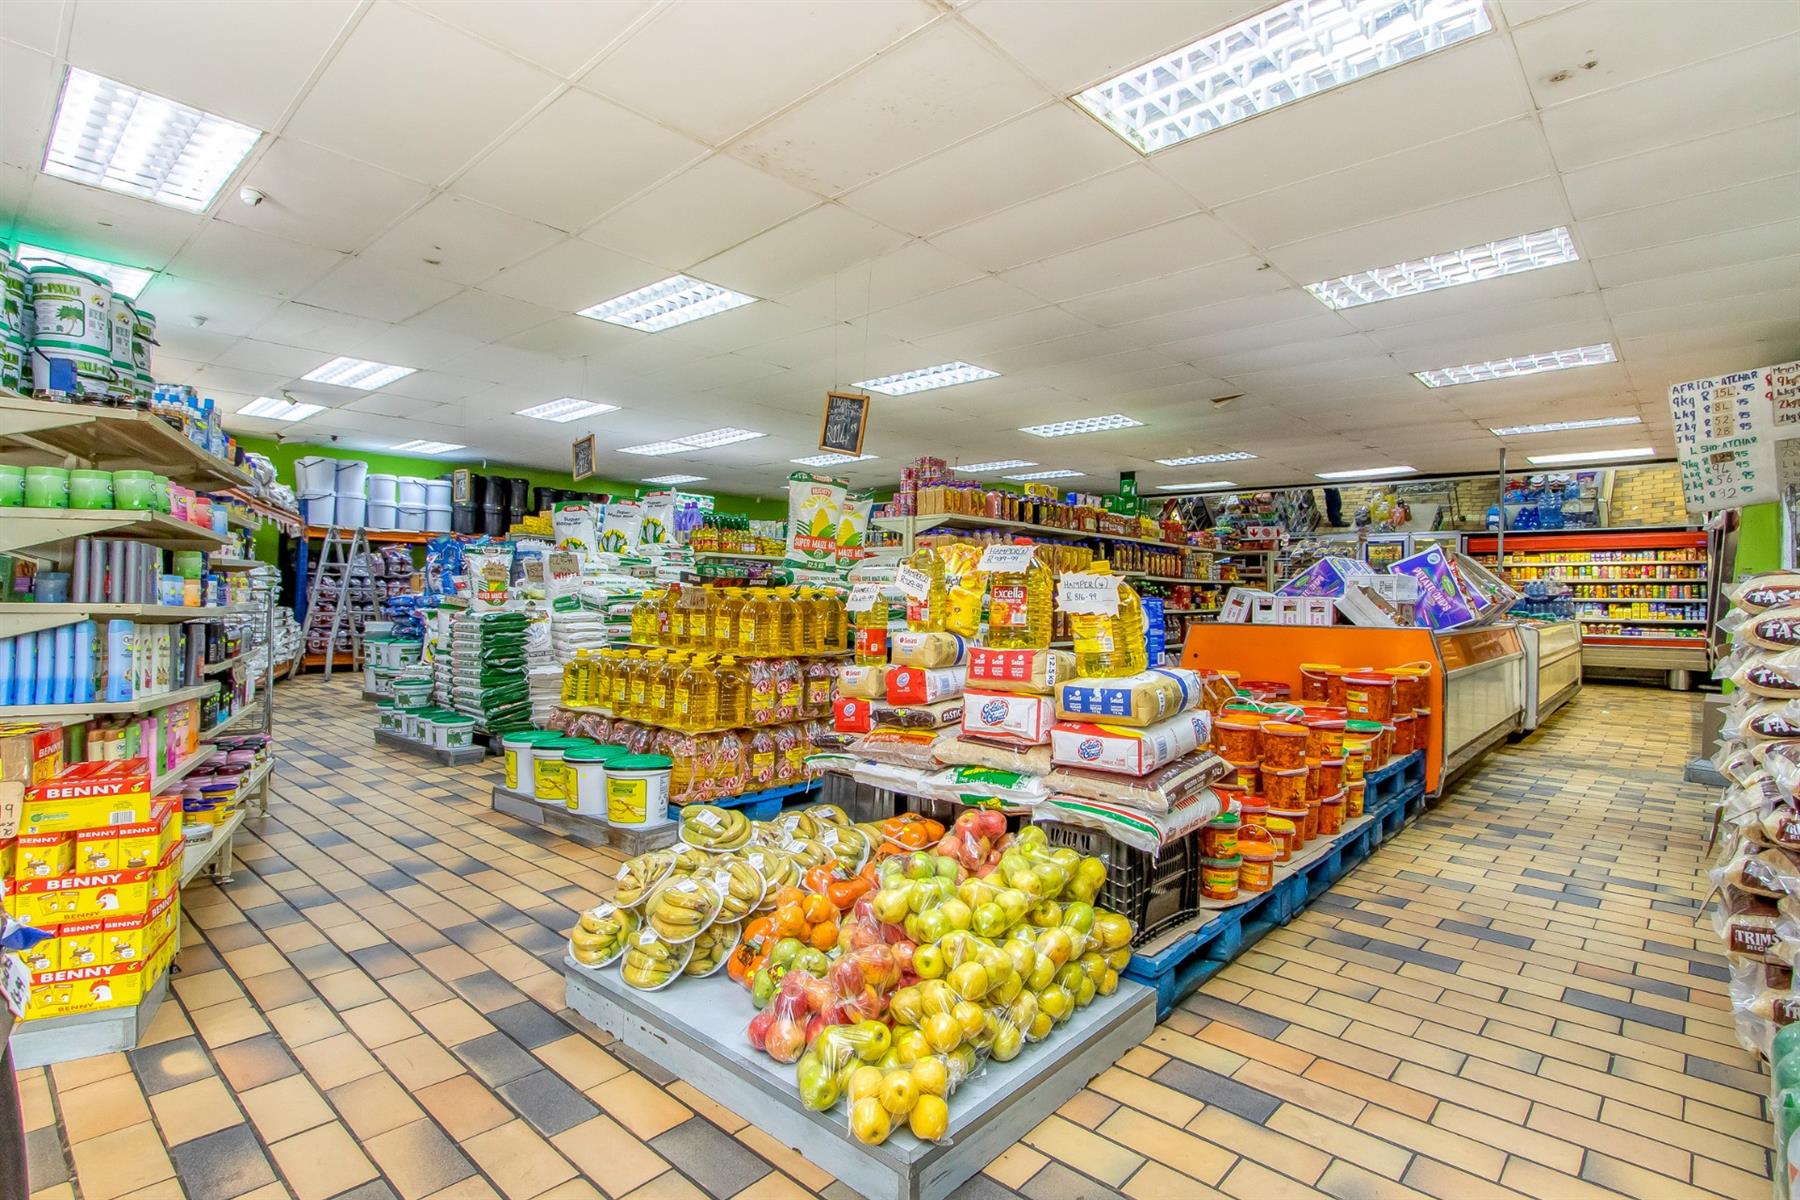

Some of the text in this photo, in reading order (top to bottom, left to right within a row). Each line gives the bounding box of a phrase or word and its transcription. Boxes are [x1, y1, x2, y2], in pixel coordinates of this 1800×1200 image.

[993, 586, 1024, 598] Excella
[943, 709, 962, 721] TASTIC
[46, 783, 123, 799] BENNY
[78, 830, 117, 839] BENNY
[119, 826, 157, 835] BENNY
[19, 836, 58, 844] BENNY
[46, 873, 123, 890] BENNY
[151, 894, 174, 917] BENNY
[63, 911, 101, 920] BENNY
[63, 923, 102, 933] BENNY
[105, 919, 142, 928] BENNY
[40, 965, 116, 984] BENNY
[58, 1002, 94, 1012] BENNY
